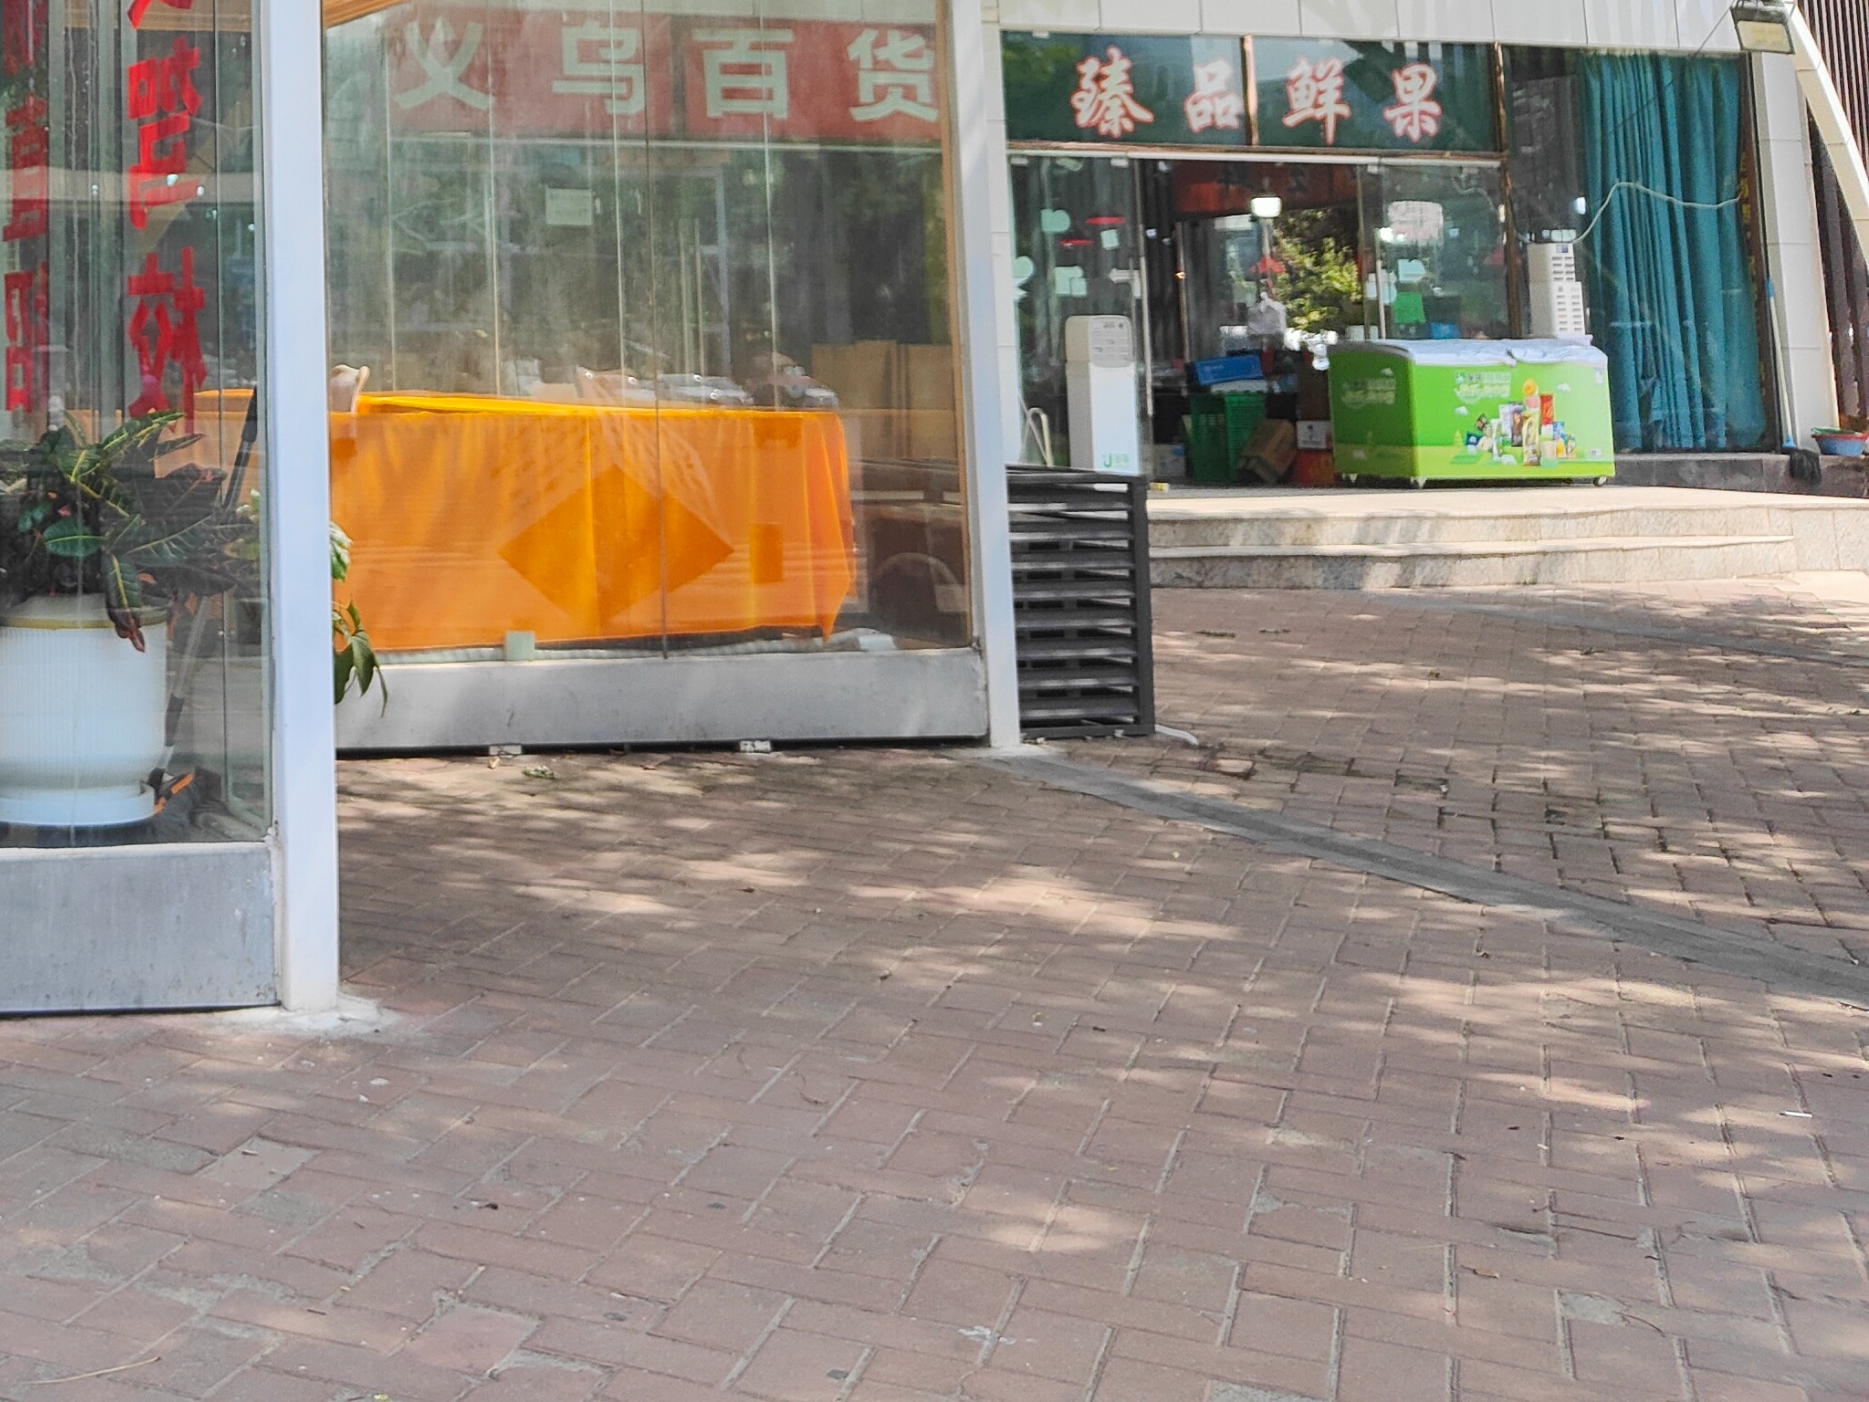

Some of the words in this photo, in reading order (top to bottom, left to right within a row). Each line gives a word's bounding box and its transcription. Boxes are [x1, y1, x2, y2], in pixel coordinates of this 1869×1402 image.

[394, 14, 939, 124] 义乌百货
[1070, 45, 1444, 144] 臻品鲜果
